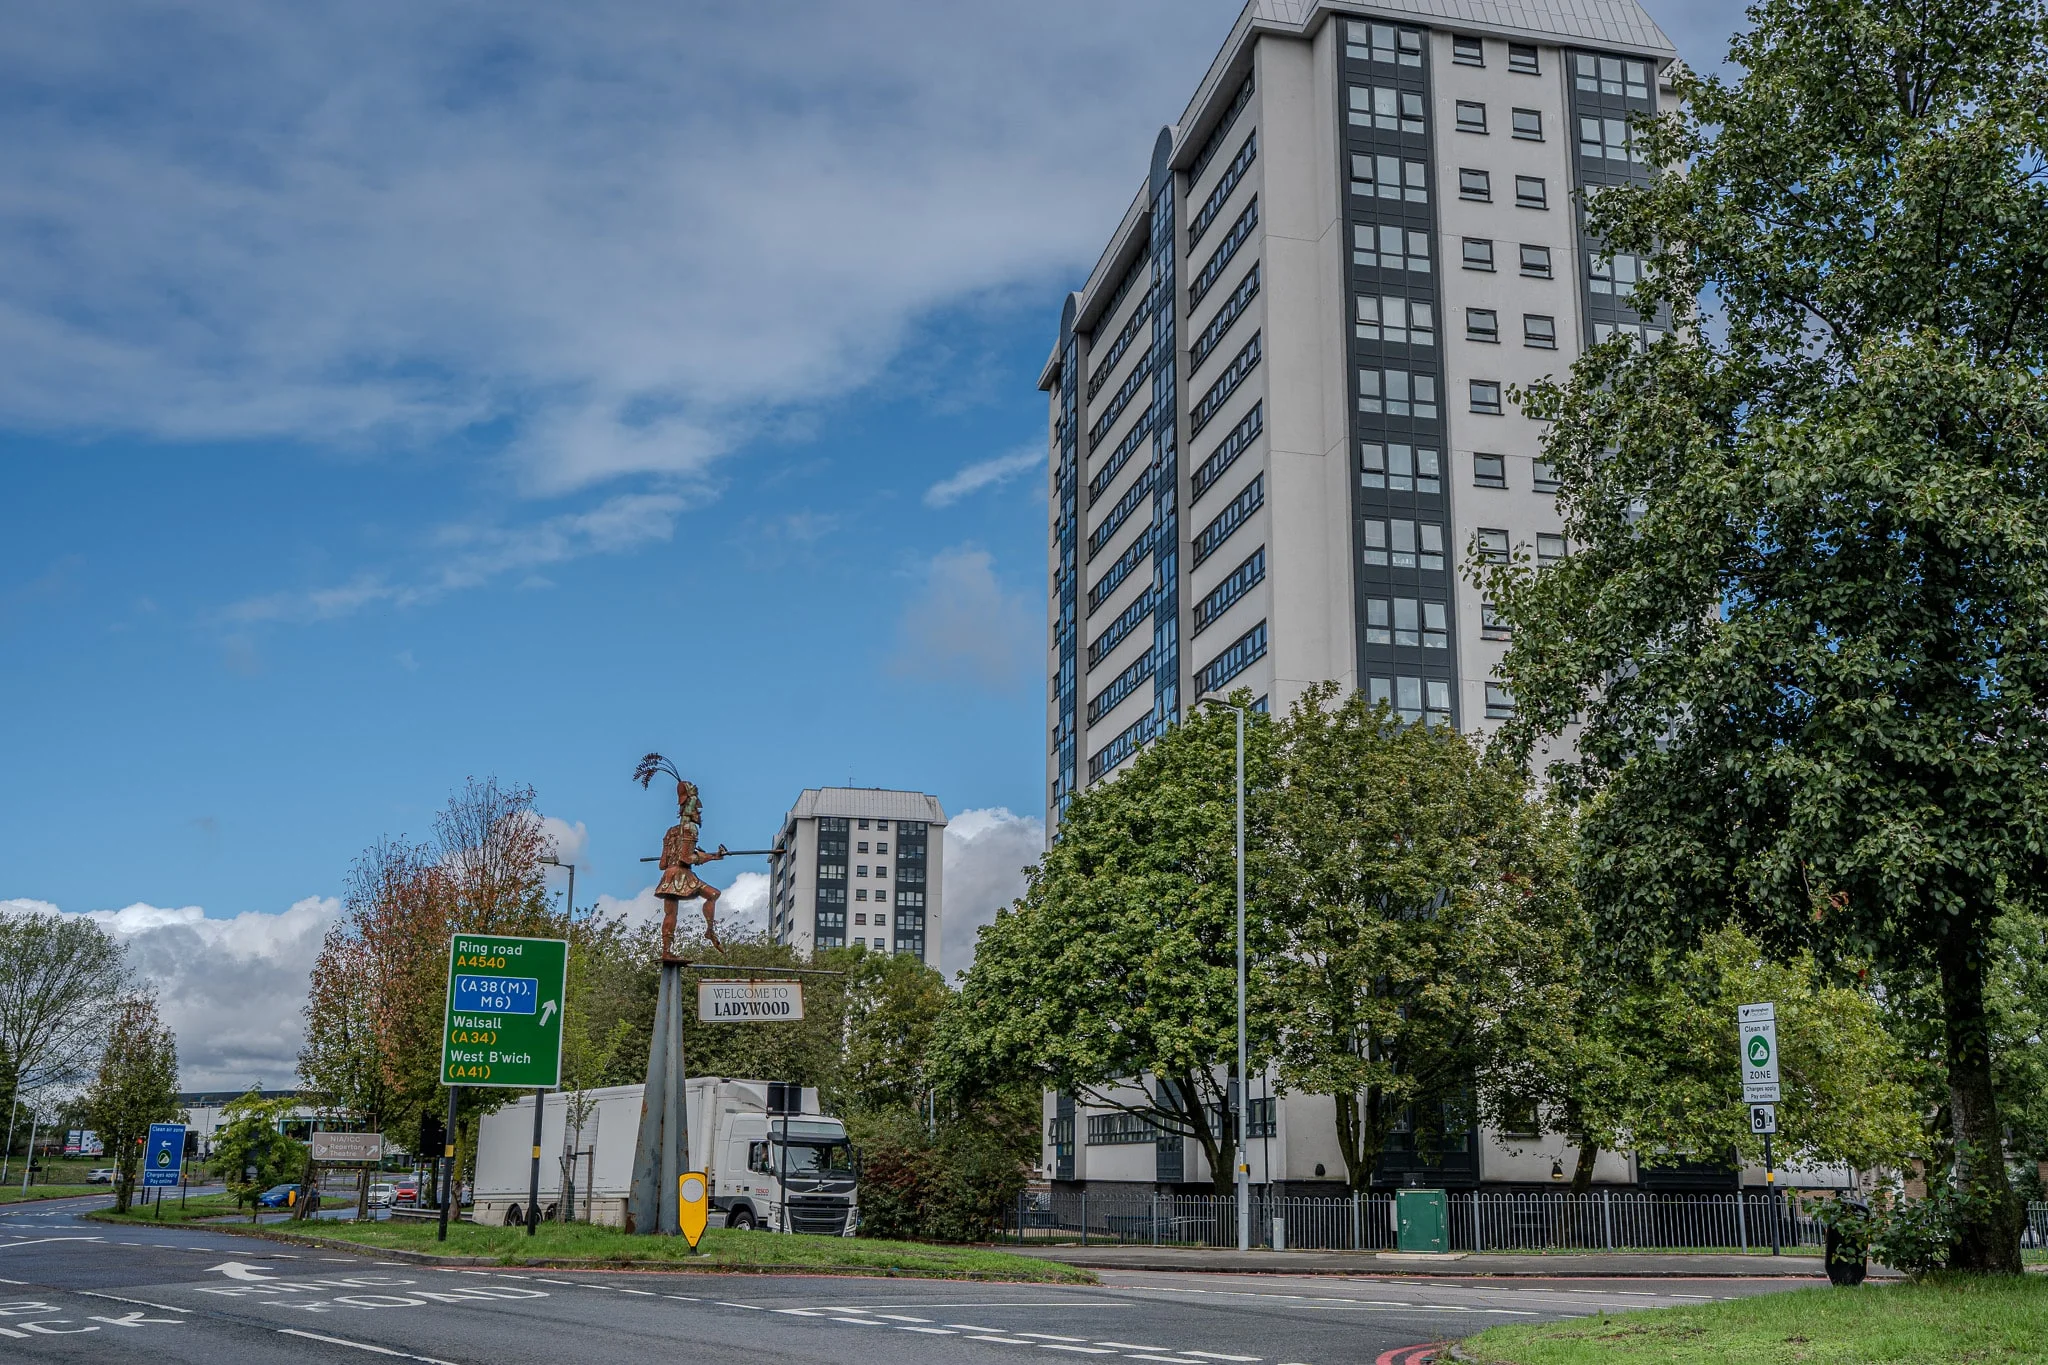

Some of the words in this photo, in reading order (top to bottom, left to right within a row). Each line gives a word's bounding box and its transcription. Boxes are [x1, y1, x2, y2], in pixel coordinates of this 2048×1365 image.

[459, 941, 488, 955] Ring
[493, 944, 523, 955] road
[457, 955, 506, 968] A4540
[713, 988, 769, 999] WELCOME
[772, 987, 788, 998] TO
[481, 996, 511, 1010] M6)
[714, 1001, 790, 1016] LADYWOOD
[453, 1016, 502, 1029] Walsall
[451, 1030, 497, 1045] (A34)
[451, 1050, 484, 1062] West
[489, 1051, 531, 1064] B'wich
[448, 1064, 491, 1079] (A41)
[1750, 1071, 1771, 1079] ZONE
[194, 1277, 416, 1296] RING
